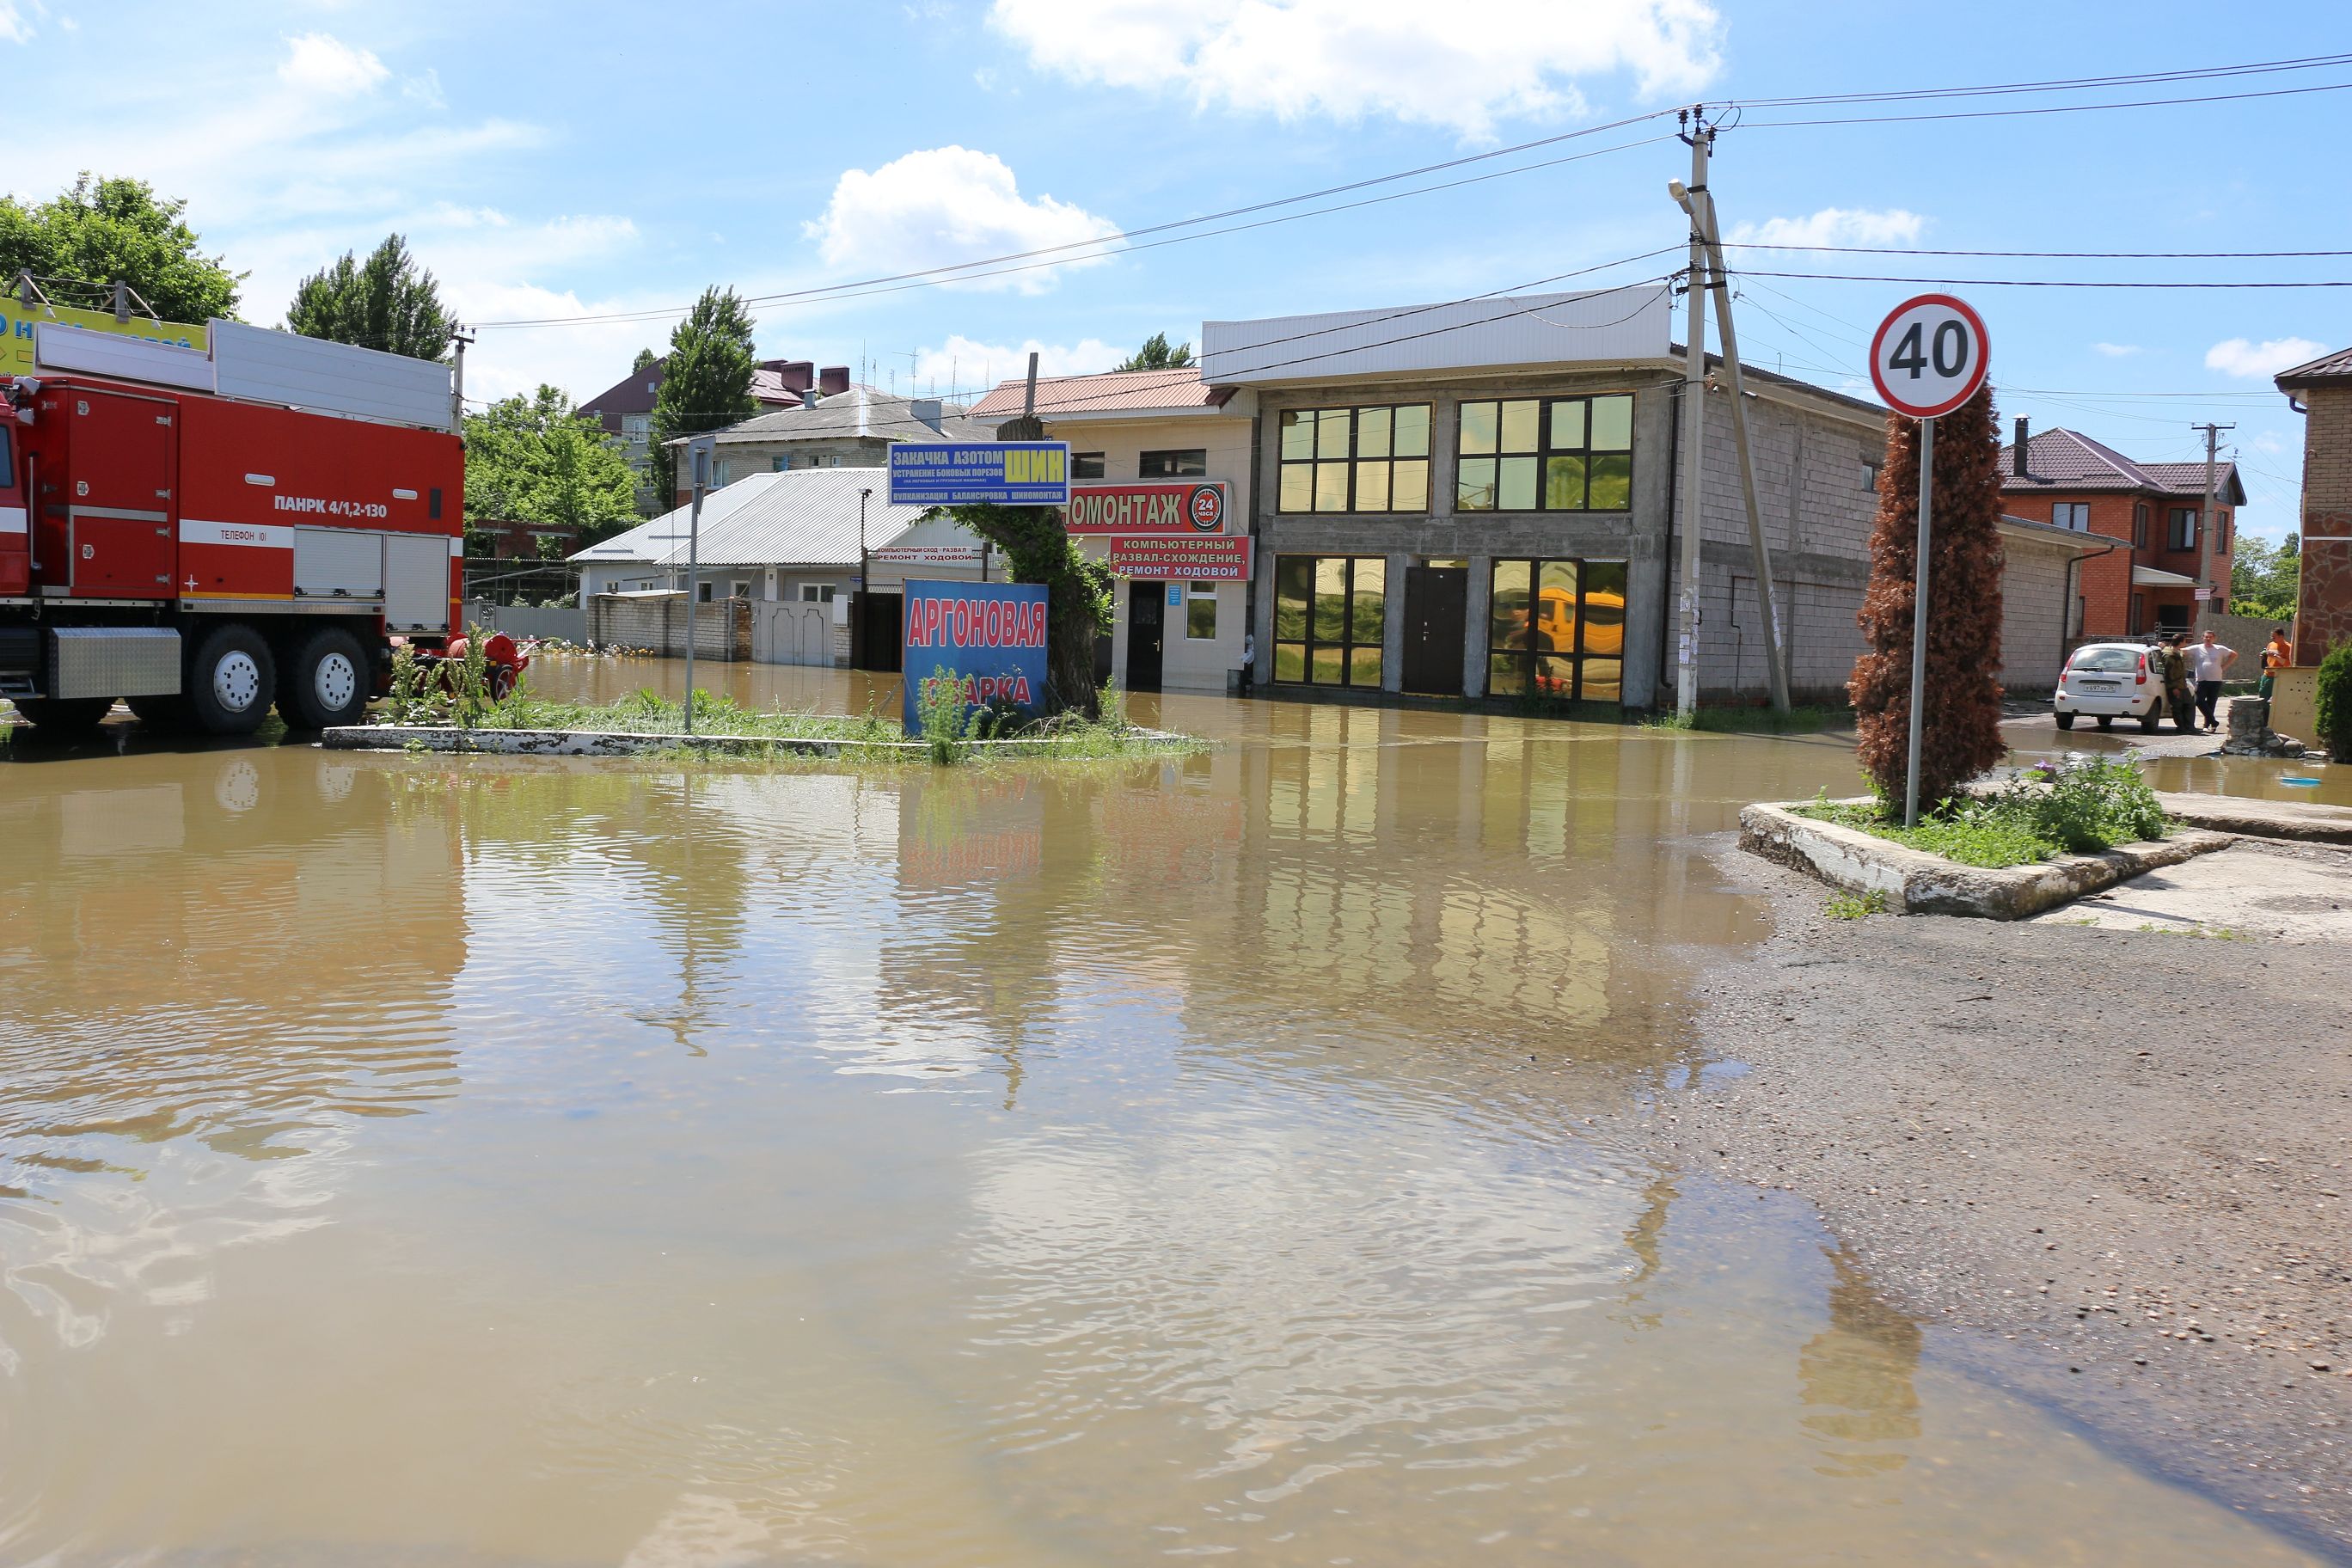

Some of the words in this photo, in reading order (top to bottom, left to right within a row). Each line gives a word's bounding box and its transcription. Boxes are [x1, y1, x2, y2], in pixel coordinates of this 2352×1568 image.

[1889, 319, 1969, 379] 40
[893, 451, 949, 466] ЗАКАЧКА
[953, 450, 1003, 465] АЗОТОМ
[1004, 450, 1065, 483] ШИН
[892, 469, 935, 478] УСТРАНЕНИЕ
[936, 469, 971, 477] БОКОВЫХ
[971, 468, 1003, 477] ПОРЕЗОВ
[893, 492, 948, 501] ВУЛКАНИЗАЦИЯ
[952, 492, 1008, 500] БАЛАНСИРОВКА
[1011, 491, 1063, 499] ШИНОМОНТАЖ
[274, 495, 326, 514] ПАНРК
[328, 500, 387, 518] 4/1,2-130
[1197, 499, 1214, 511] 24
[220, 530, 254, 542] ТЕЛЕФОН
[1123, 539, 1235, 550] КОМПЬЮТЕРНЫЙ
[1113, 553, 1246, 565] РАЗВАЛ-СХОЖДЕНИЕ,
[1118, 566, 1170, 576] РЕМОНТ
[1174, 565, 1239, 577] ХОДОВОЙ
[907, 597, 1046, 648] АРГОНОВАЯ
